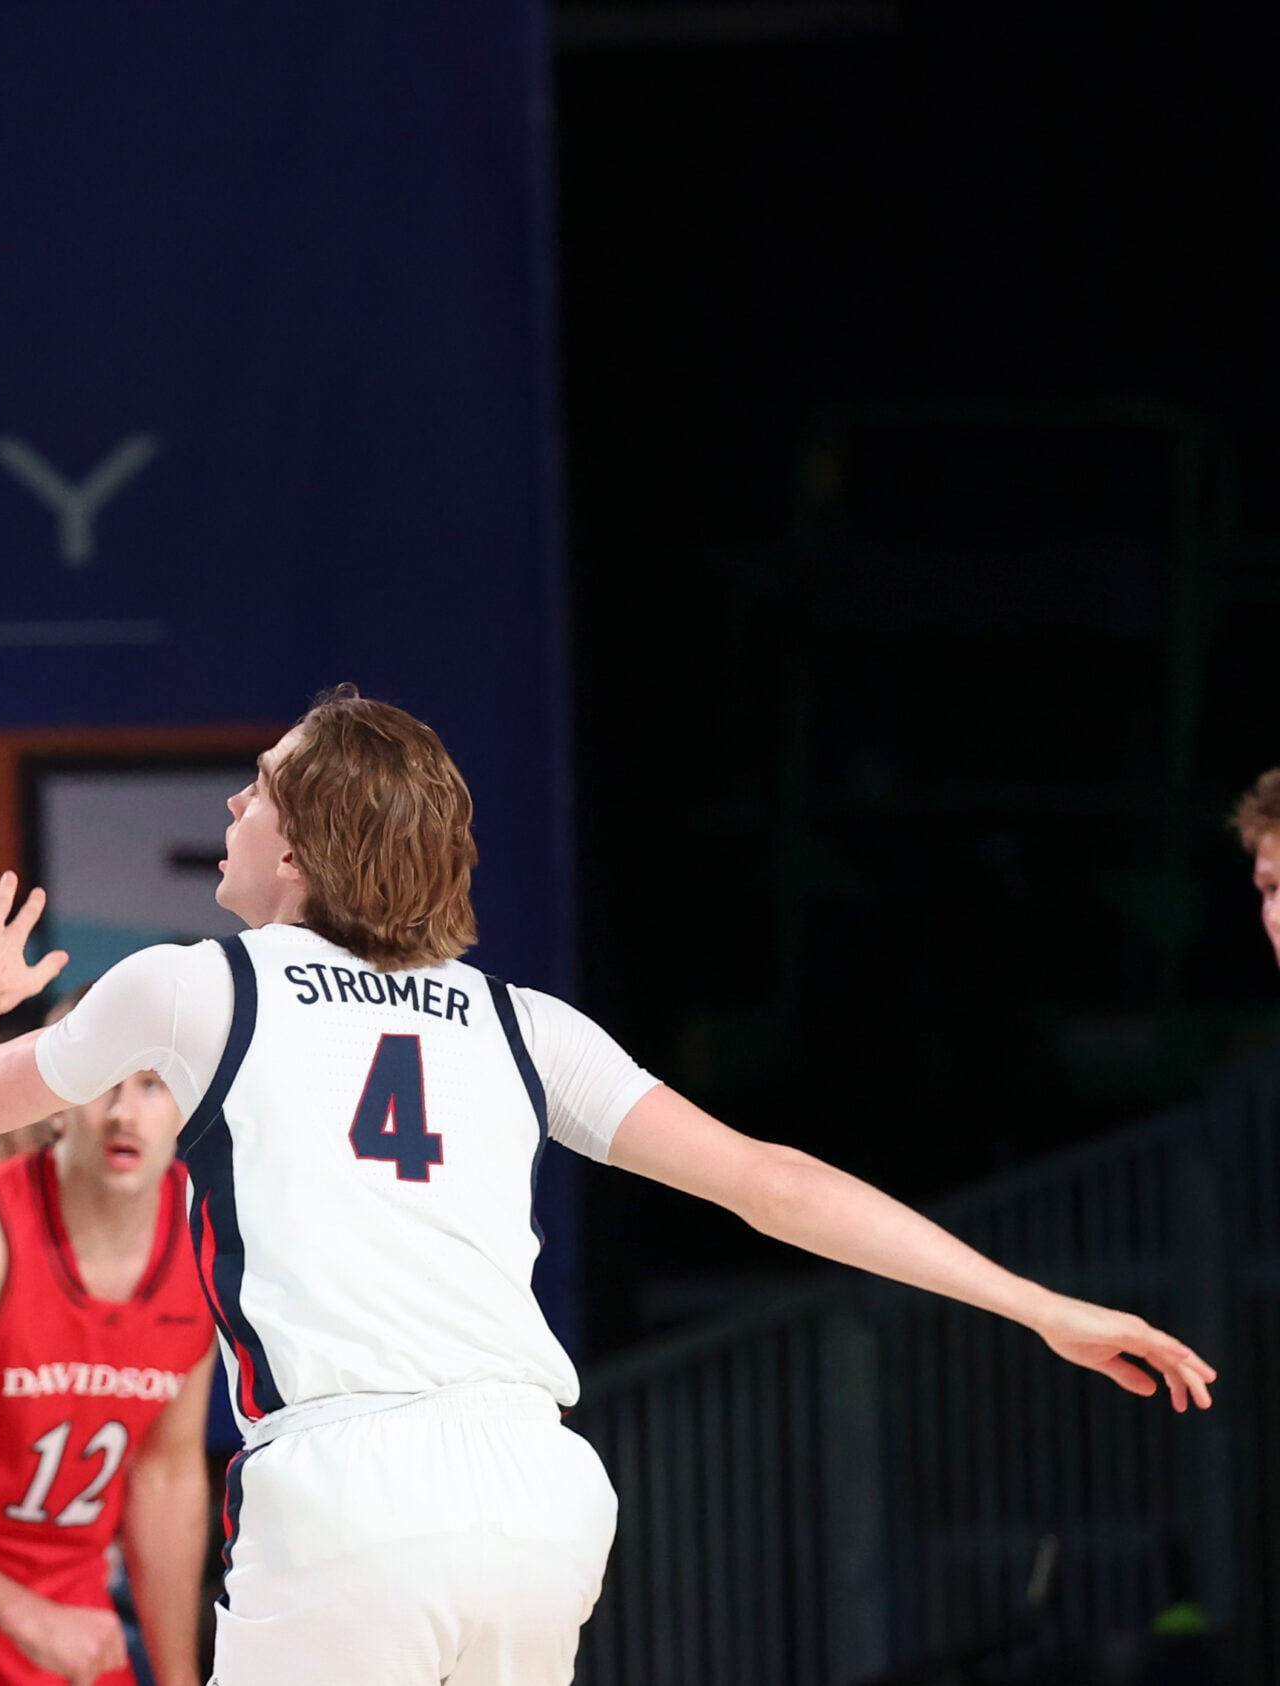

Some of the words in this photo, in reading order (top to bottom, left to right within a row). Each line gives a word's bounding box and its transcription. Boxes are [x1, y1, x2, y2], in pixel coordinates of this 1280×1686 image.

[284, 963, 470, 1027] STROMER
[348, 1033, 444, 1183] 4
[2, 1361, 187, 1401] DAVIDSON
[4, 1420, 129, 1527] 12
